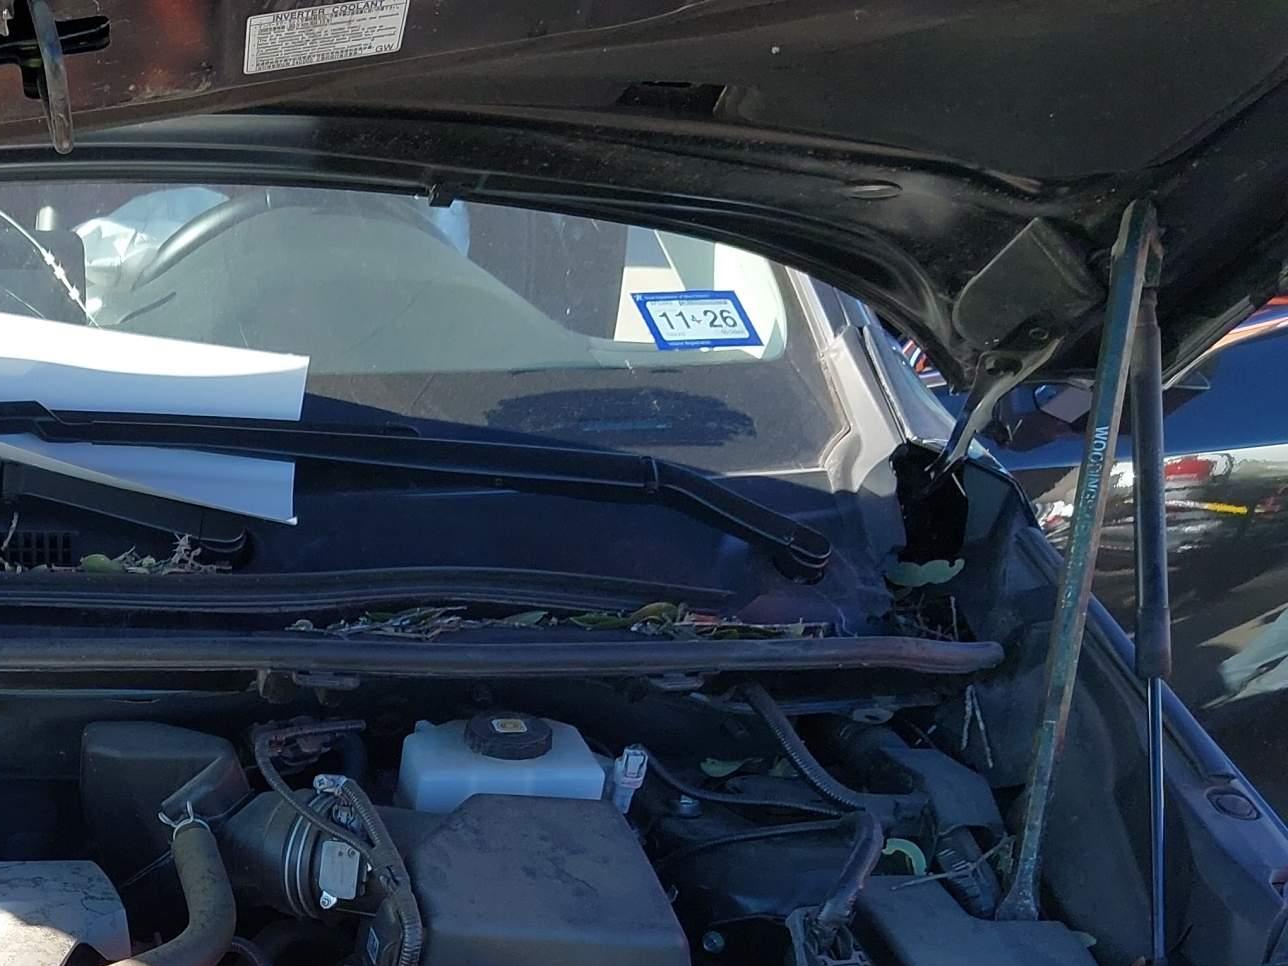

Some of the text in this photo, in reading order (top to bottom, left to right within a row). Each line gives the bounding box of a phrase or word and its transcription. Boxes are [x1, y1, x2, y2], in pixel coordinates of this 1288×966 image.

[272, 0, 385, 23] INVERTER COOLANT
[375, 43, 394, 53] GW
[658, 309, 738, 330] 11 26
